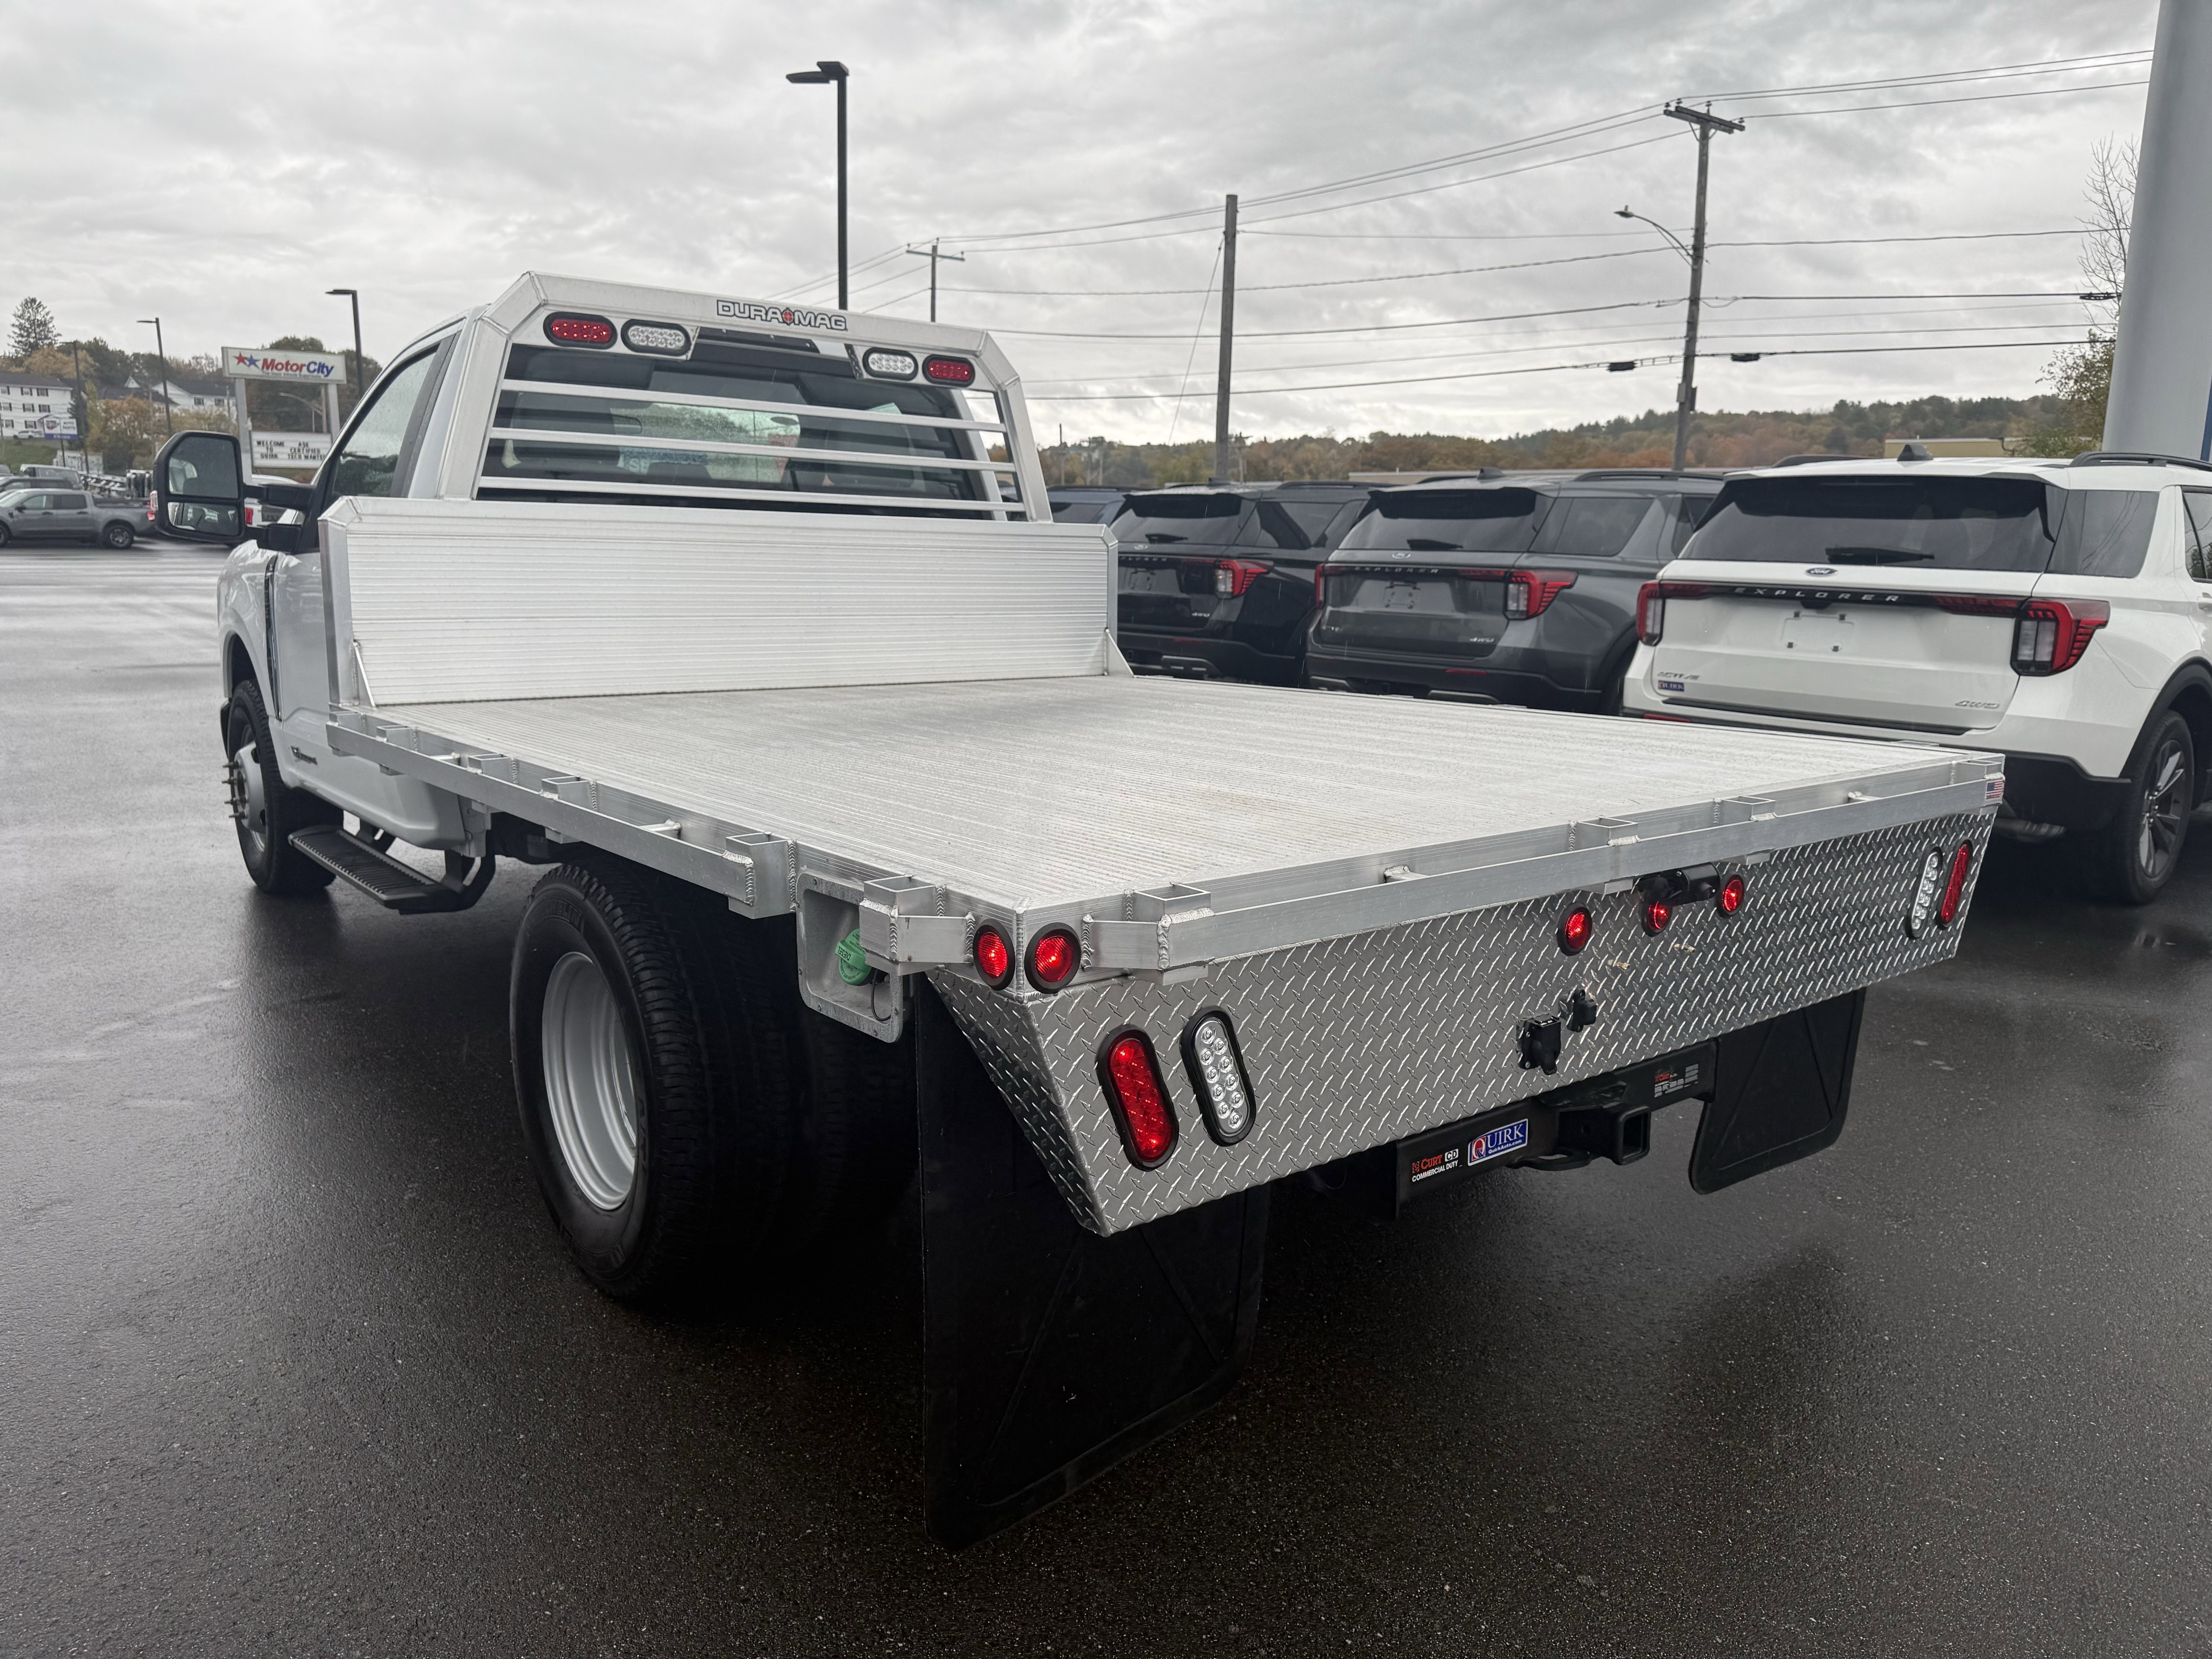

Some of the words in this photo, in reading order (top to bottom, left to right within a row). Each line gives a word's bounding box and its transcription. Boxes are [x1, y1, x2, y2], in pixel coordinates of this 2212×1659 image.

[261, 358, 335, 377] MotorCity
[1734, 587, 1899, 602] EXPLORER
[1657, 672, 1700, 680] ACTIVE
[1955, 700, 1999, 709] 4WD
[1472, 1123, 1525, 1159] QUIRK
[1488, 1139, 1522, 1154] QuirkAuto.com
[1421, 1154, 1443, 1170] CURT
[1446, 1150, 1457, 1160] CD
[1412, 1165, 1446, 1182] COMMERCIAL
[1446, 1159, 1458, 1170] DUTY
